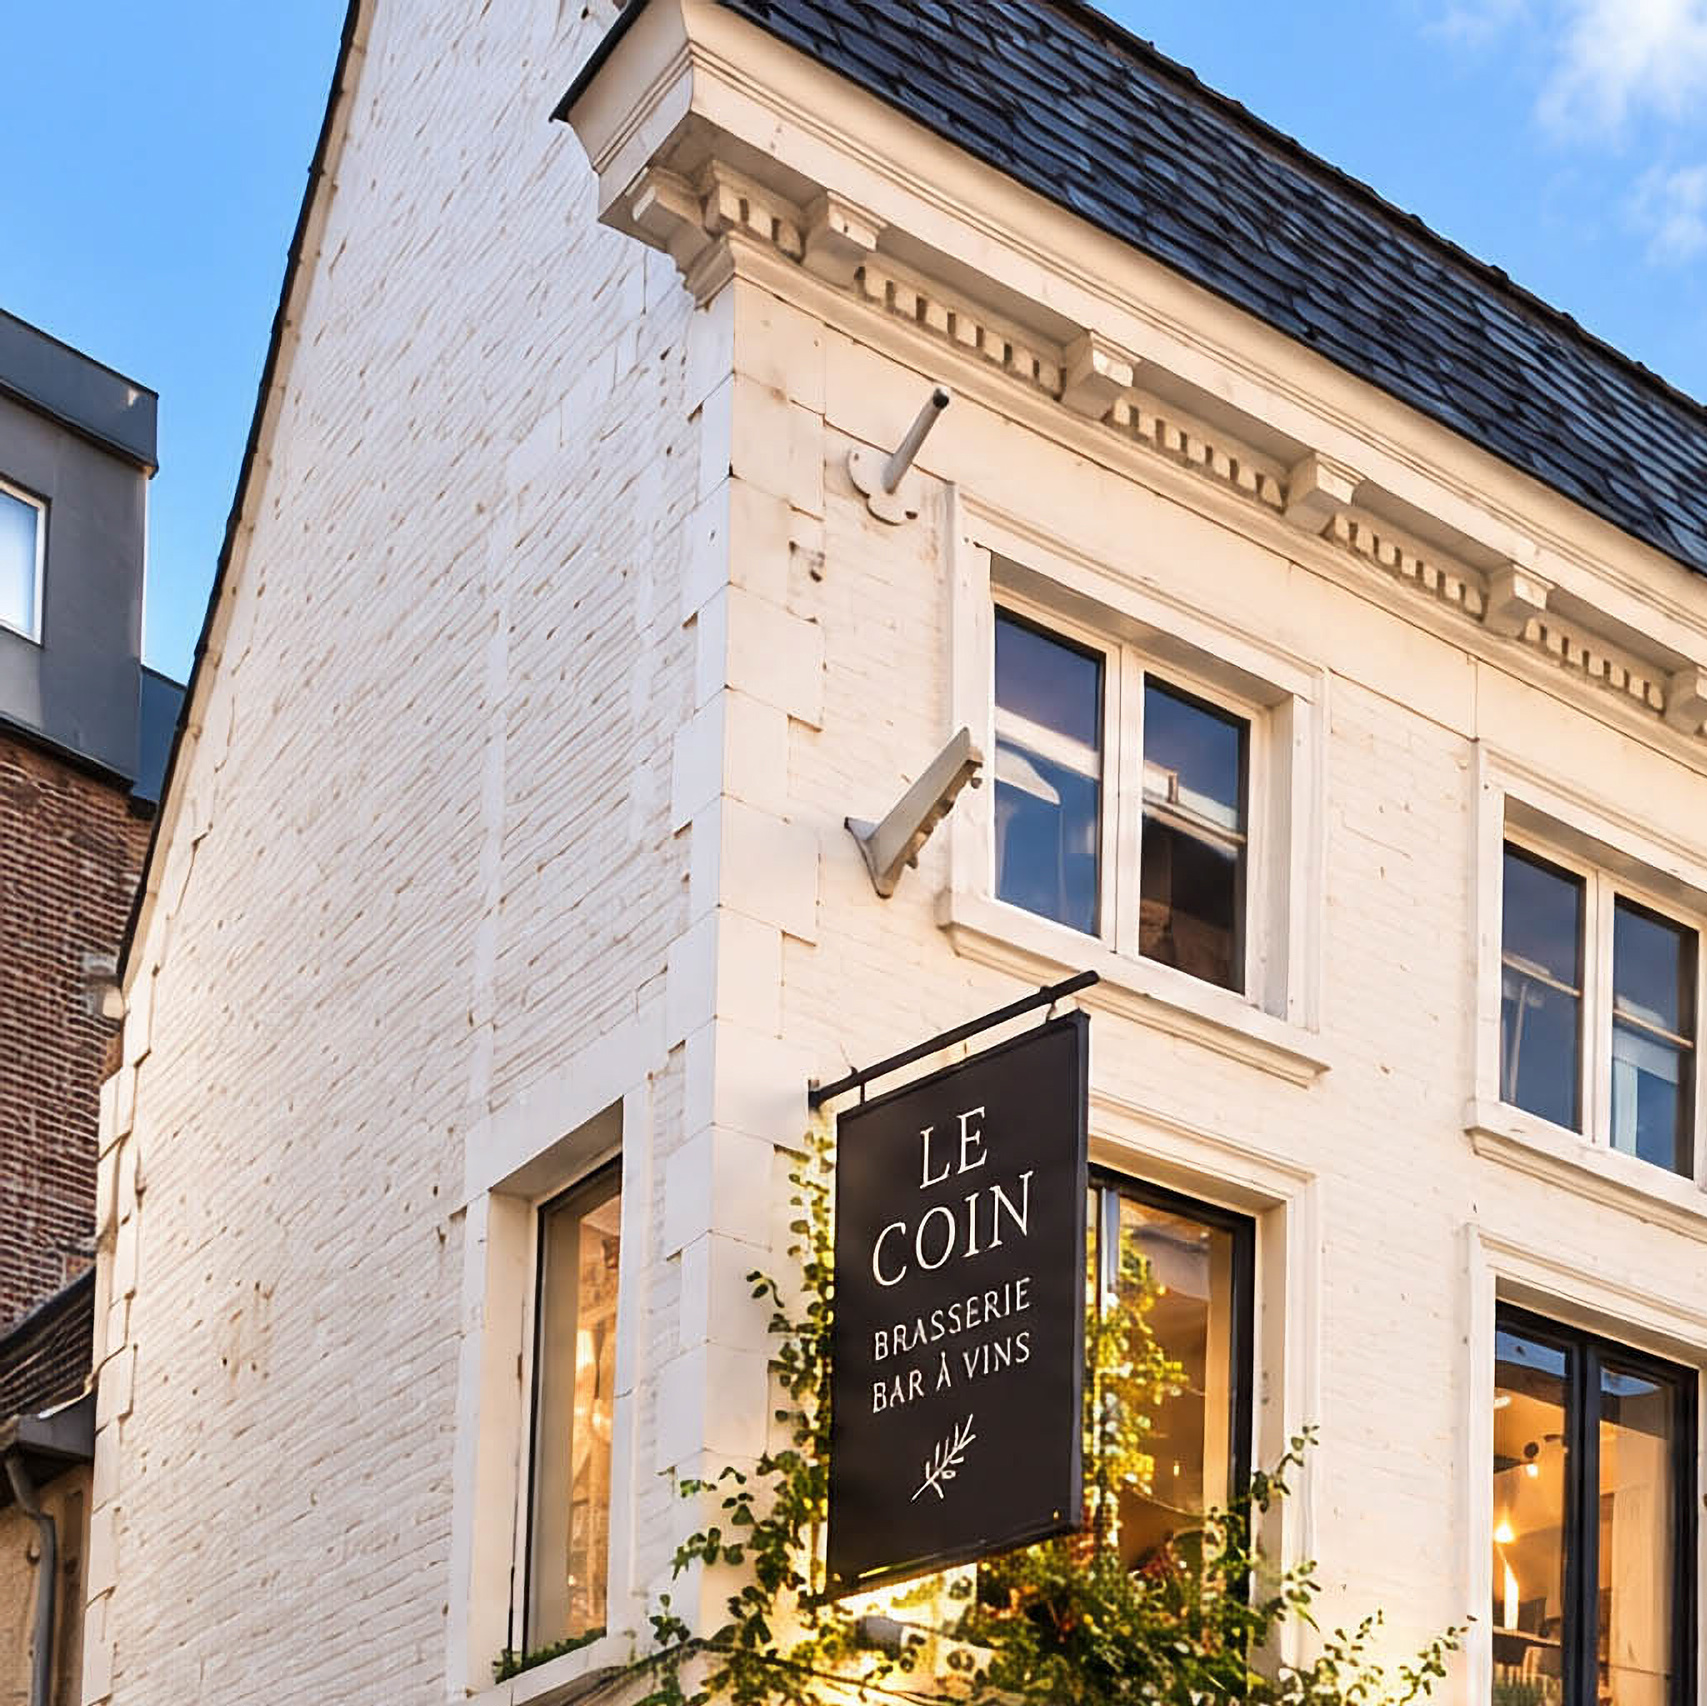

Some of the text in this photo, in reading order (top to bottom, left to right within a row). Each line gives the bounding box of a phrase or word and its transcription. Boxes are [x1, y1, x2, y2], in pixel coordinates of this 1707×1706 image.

[919, 1106, 988, 1190] LE
[872, 1170, 1034, 1286] COIN
[874, 1277, 1031, 1361] BRASSERIE
[872, 1369, 925, 1414] BAR
[962, 1331, 1031, 1379] VINS
